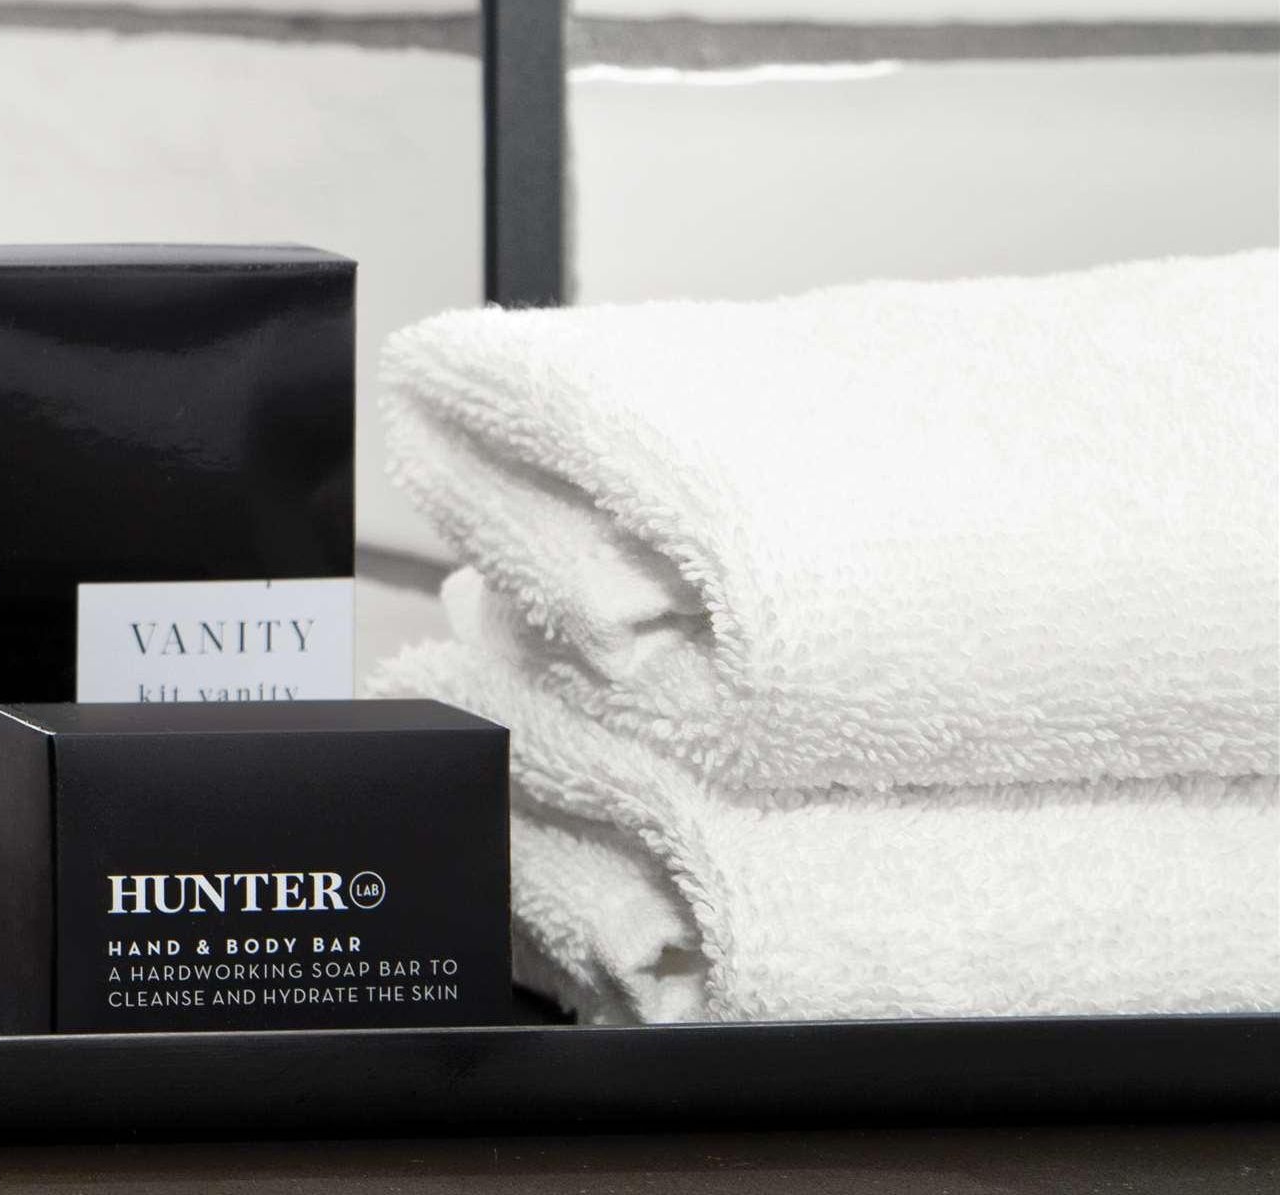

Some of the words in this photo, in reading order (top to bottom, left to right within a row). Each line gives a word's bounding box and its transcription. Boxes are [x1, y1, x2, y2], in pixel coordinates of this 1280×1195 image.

[130, 619, 316, 656] VANITY
[139, 683, 183, 703] kit
[107, 871, 349, 914] HUNTER
[108, 939, 181, 957] HAND
[196, 939, 210, 955] &
[226, 937, 297, 955] BODY
[313, 936, 361, 953] BAR
[108, 967, 121, 982] A
[131, 961, 303, 982] HARDWORKING
[312, 960, 370, 979] SOAP
[379, 959, 421, 977] BAR
[430, 959, 458, 975] TO
[108, 989, 204, 1008] CLEANSE
[212, 989, 256, 1005] AND
[263, 987, 358, 1005] HYDRATE
[366, 986, 404, 1002] THE
[411, 984, 457, 1001] SKIN
